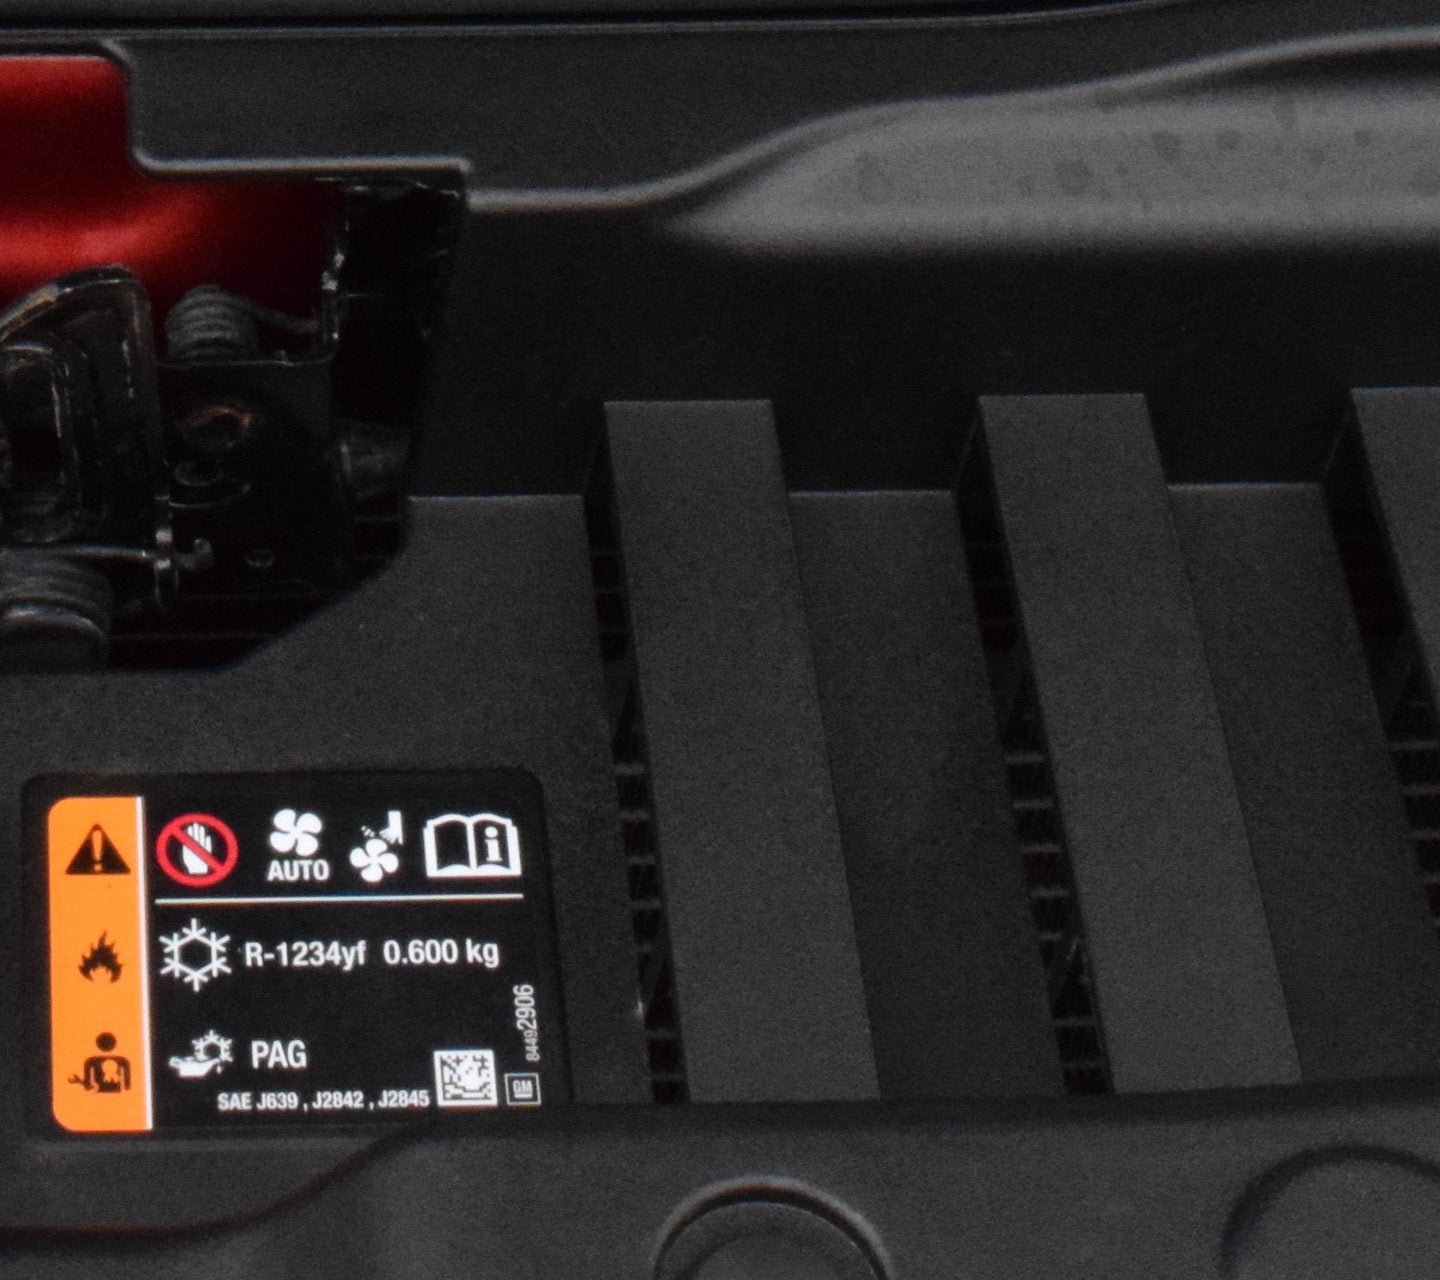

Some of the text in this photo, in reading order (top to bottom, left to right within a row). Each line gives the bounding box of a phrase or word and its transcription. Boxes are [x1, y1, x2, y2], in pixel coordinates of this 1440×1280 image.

[266, 859, 331, 882] AUTO
[244, 937, 500, 971] R-1234yf 0.600 kg
[251, 1039, 308, 1070] PAG
[217, 1091, 252, 1111] SAE
[377, 1089, 431, 1109] J2845
